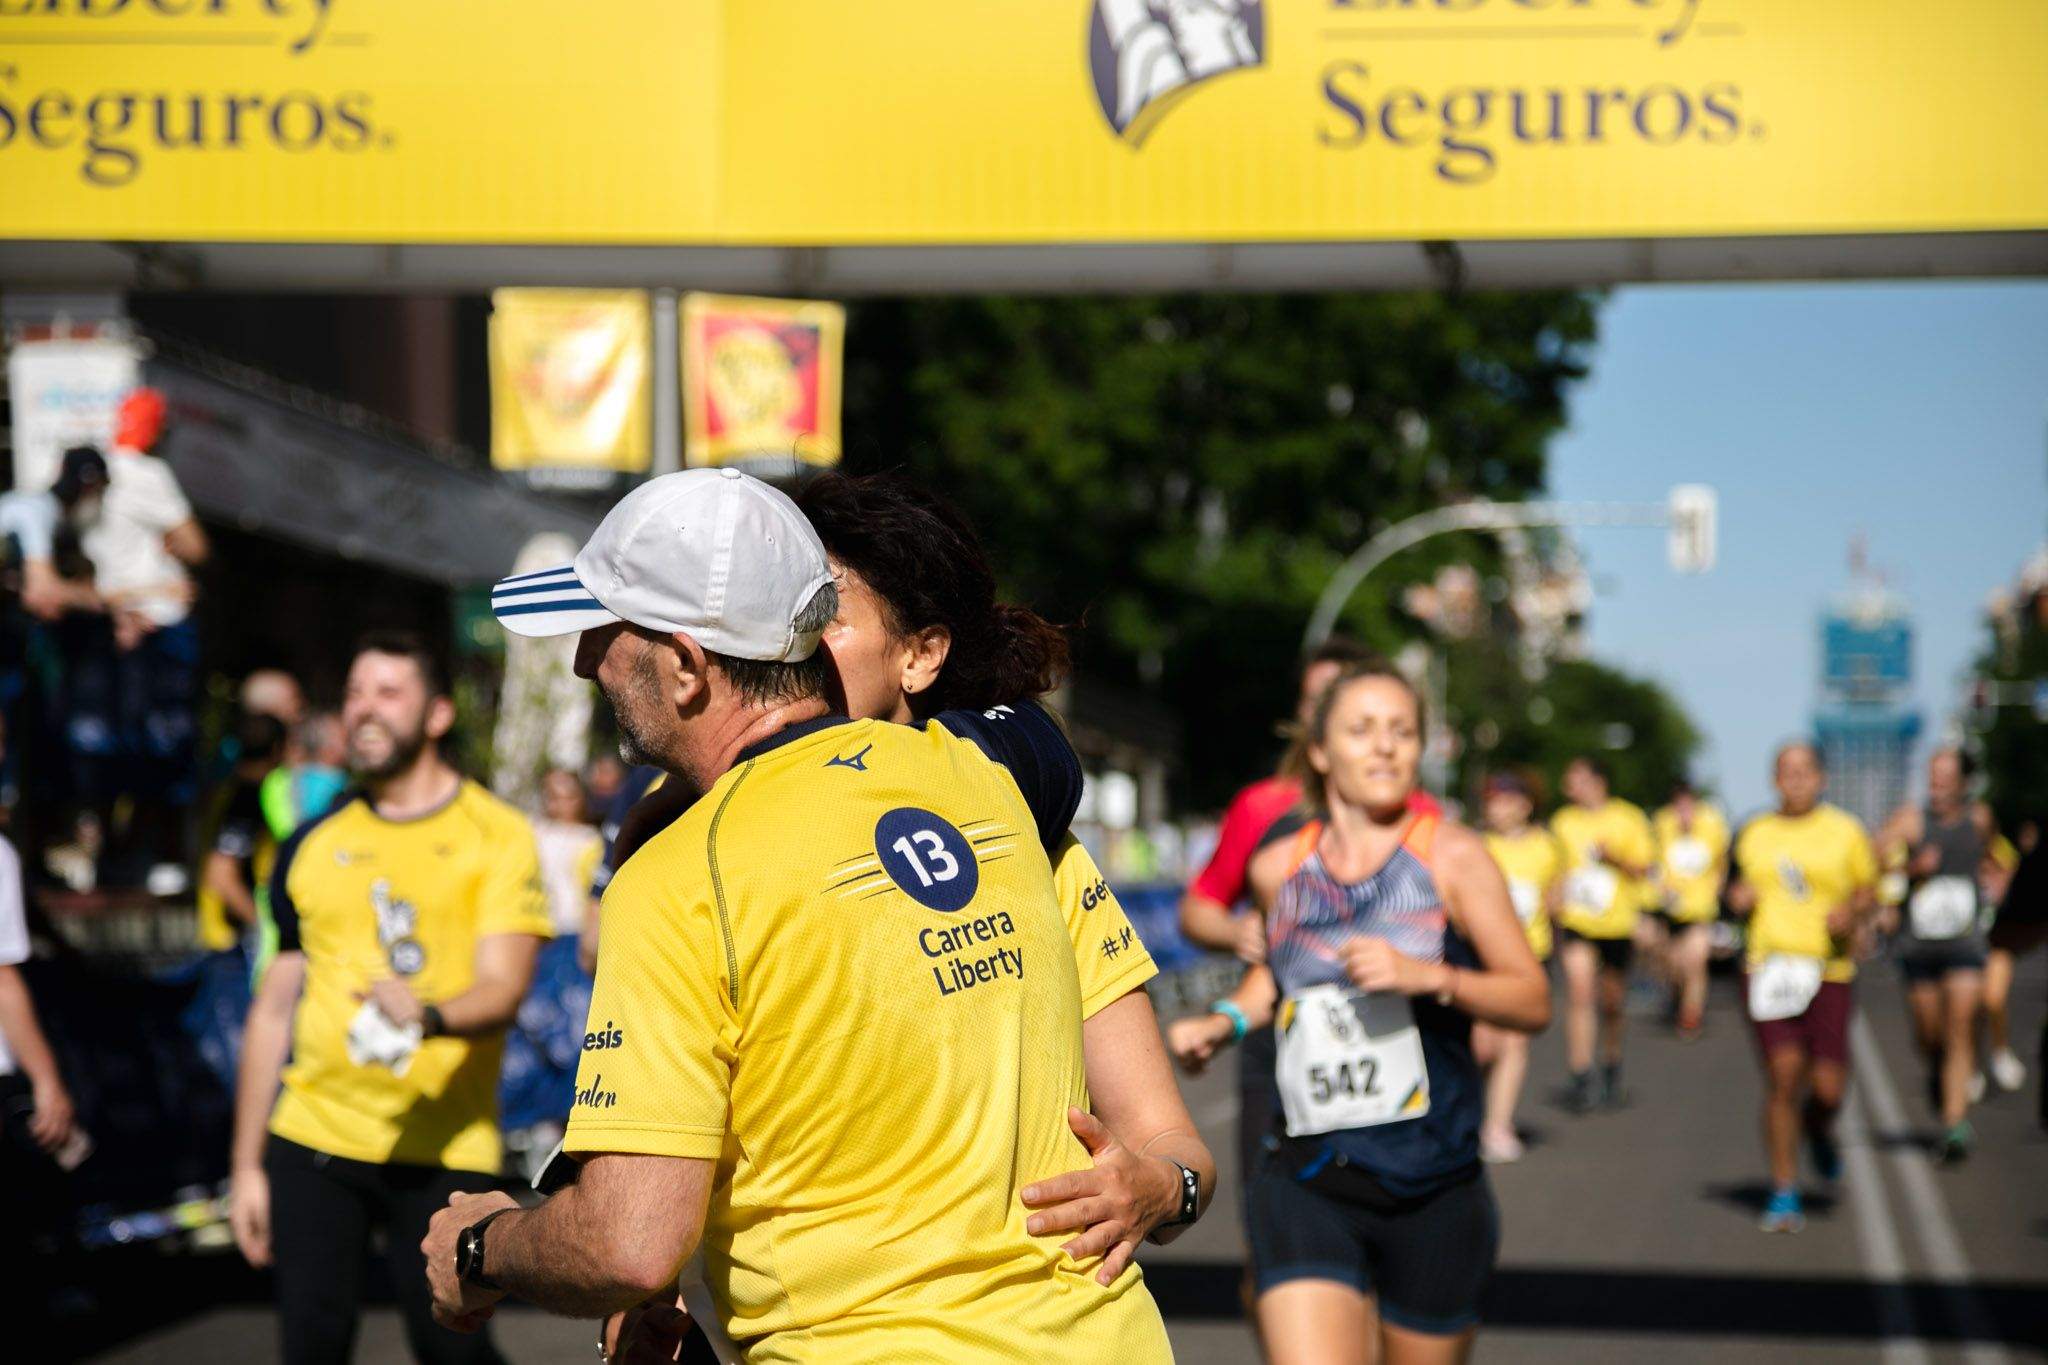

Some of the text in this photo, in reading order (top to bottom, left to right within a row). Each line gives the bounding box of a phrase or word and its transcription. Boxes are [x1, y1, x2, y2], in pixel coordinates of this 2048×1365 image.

[892, 830, 959, 887] 13
[918, 911, 1015, 957] Carrera
[932, 948, 1024, 996] Liberty
[582, 1020, 623, 1051] esis
[575, 1073, 617, 1109] alen
[1309, 1056, 1382, 1103] 542
